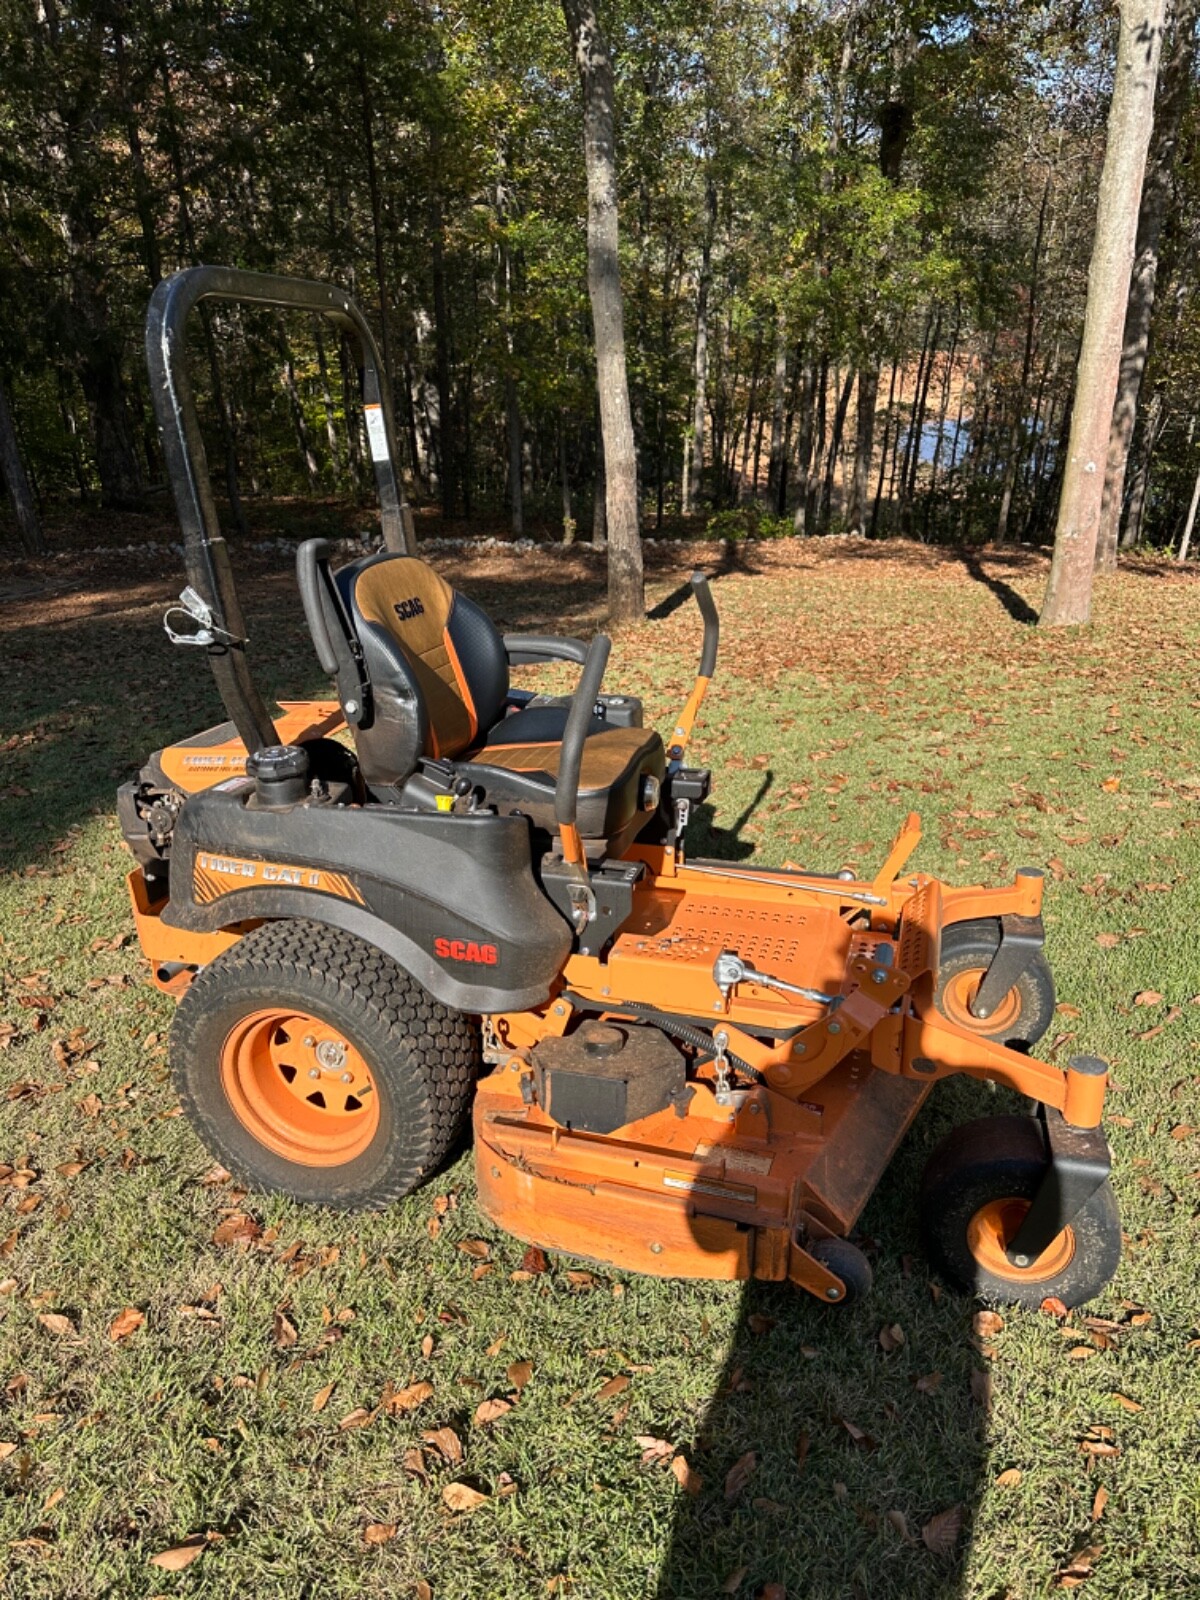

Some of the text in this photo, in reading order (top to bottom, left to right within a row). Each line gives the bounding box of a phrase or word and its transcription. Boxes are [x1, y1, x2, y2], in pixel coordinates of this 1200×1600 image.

[393, 597, 424, 621] SCAG
[201, 856, 256, 877] TIGER
[262, 866, 304, 885] CAT
[434, 937, 498, 965] SCAG
